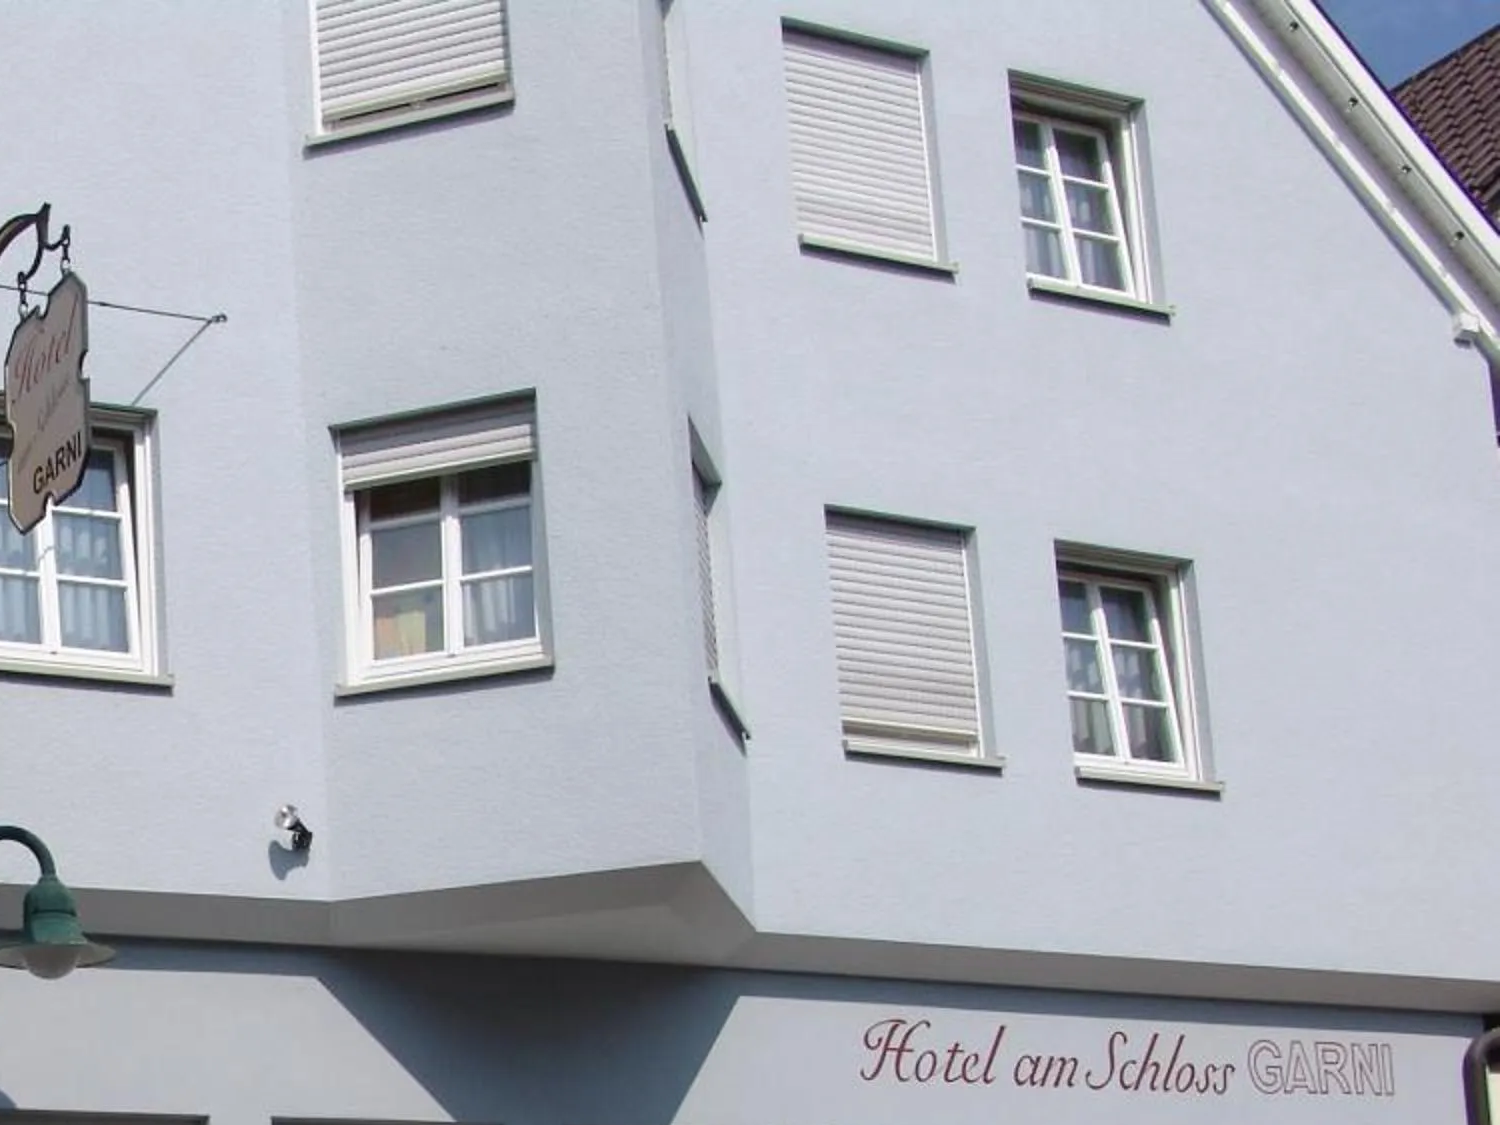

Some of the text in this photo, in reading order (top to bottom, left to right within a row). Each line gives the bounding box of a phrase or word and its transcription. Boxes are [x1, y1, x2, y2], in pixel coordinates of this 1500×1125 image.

[13, 292, 79, 397] Hotel
[32, 432, 83, 496] GARNI
[859, 1018, 1395, 1096] Hotel am Schloss GARNI
